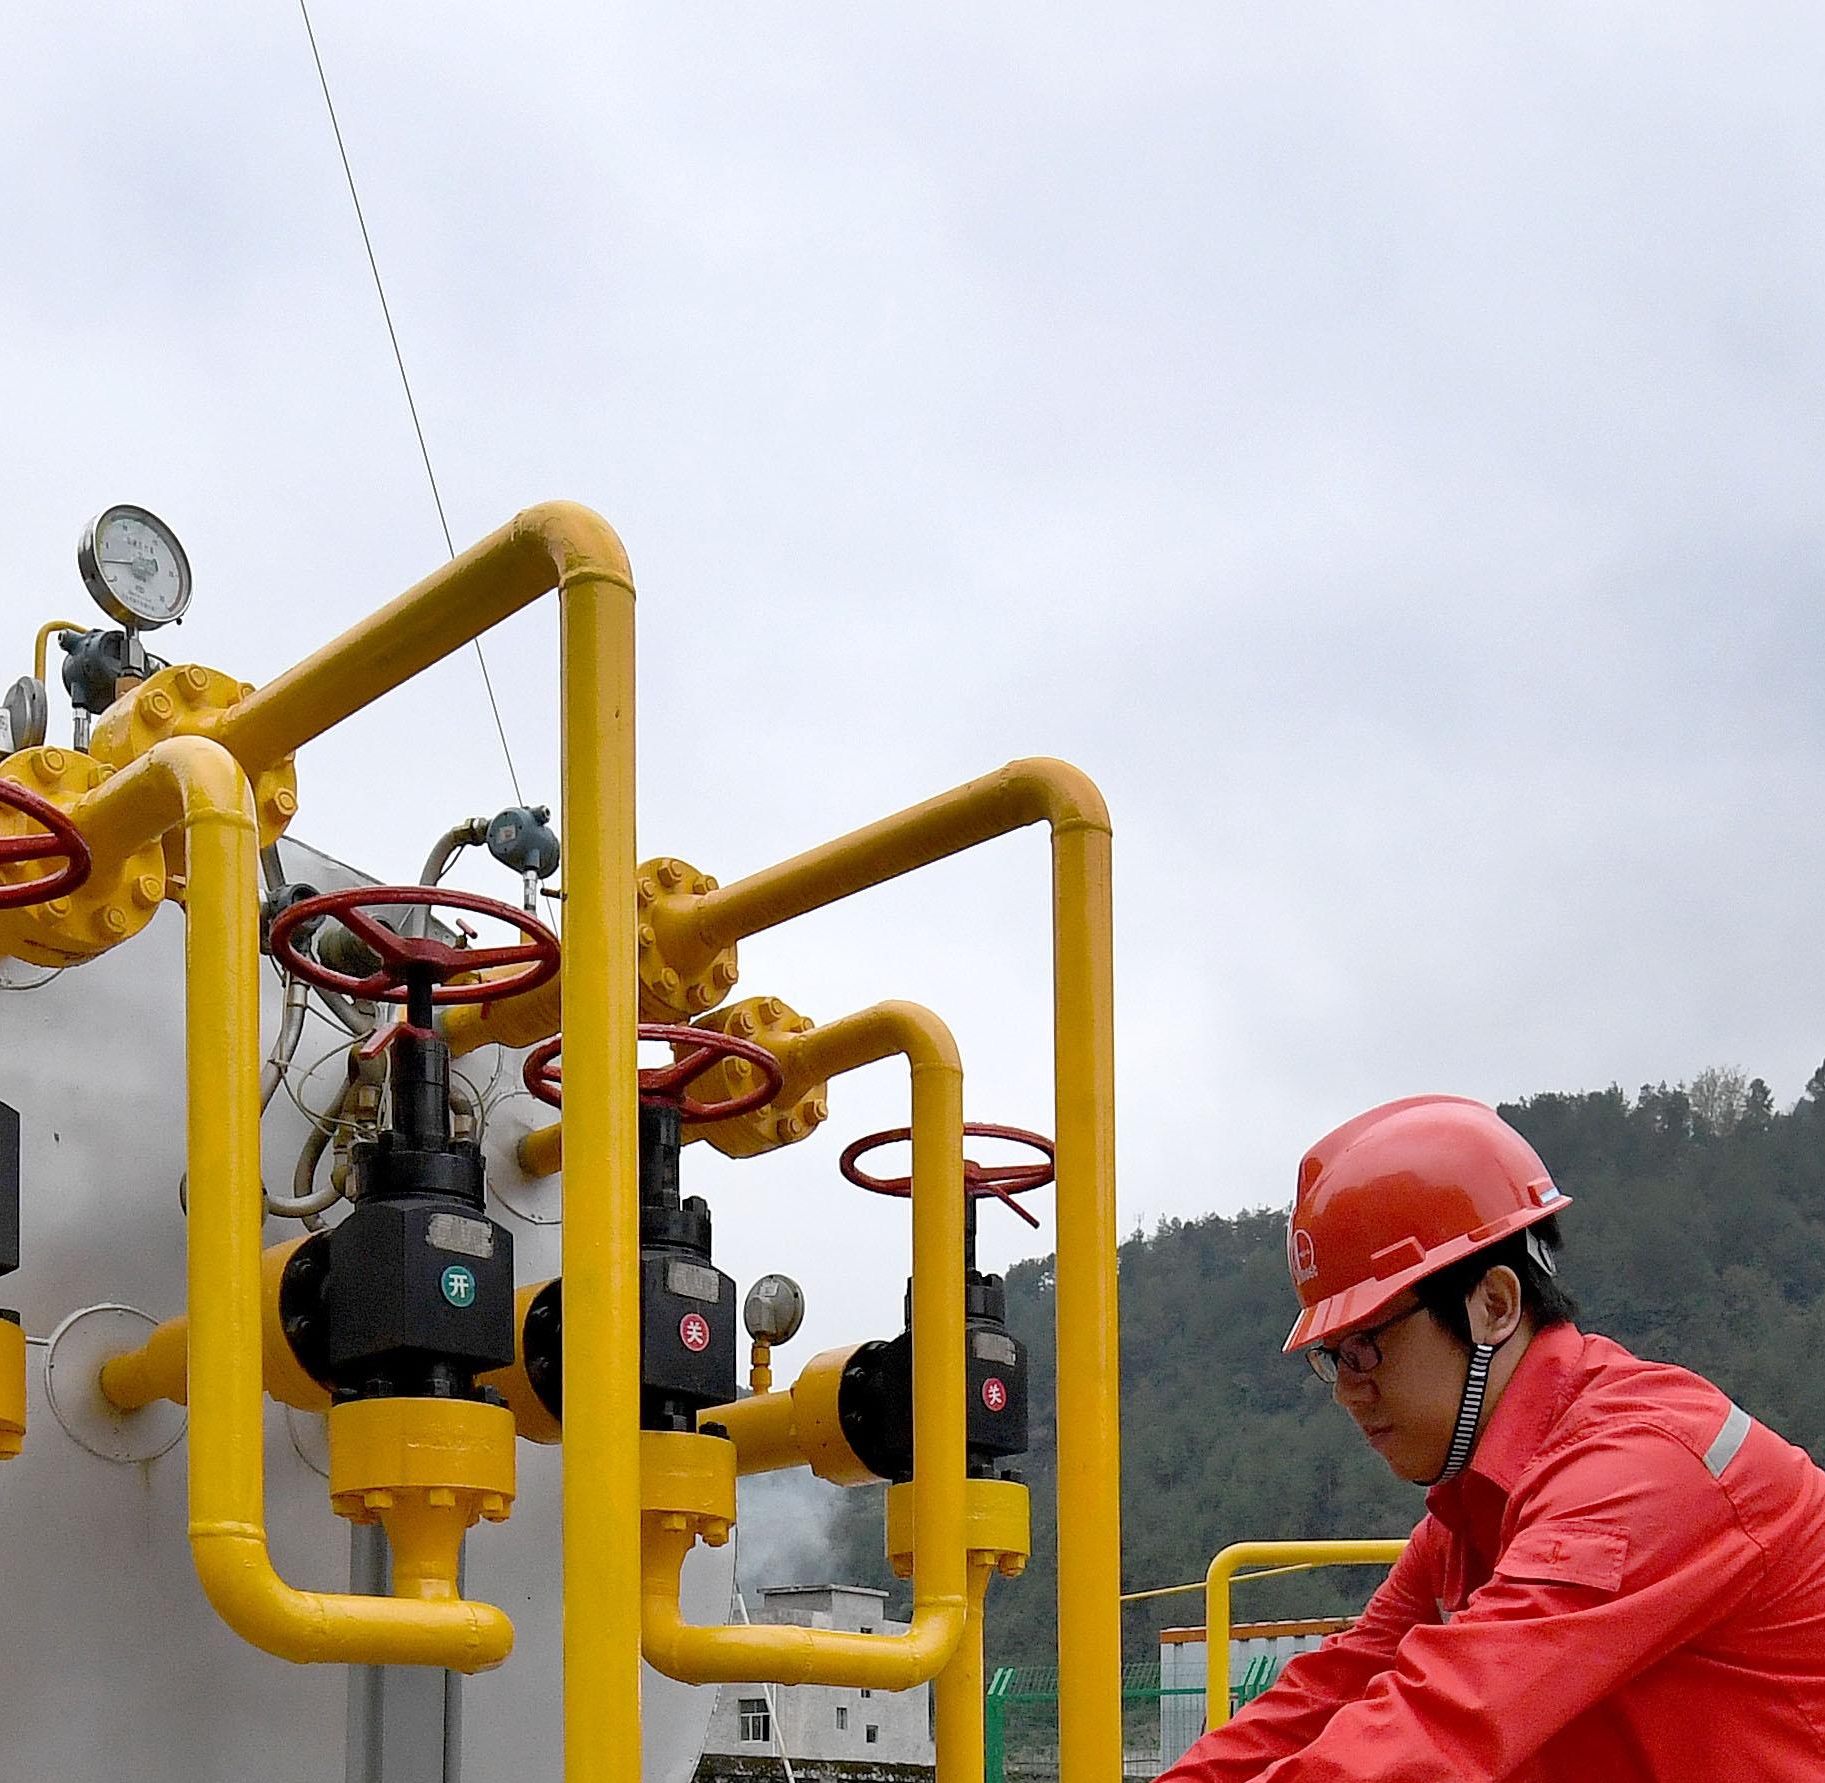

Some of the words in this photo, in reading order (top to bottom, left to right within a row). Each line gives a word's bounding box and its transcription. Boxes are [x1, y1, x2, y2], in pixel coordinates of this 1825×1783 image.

[448, 1273, 469, 1299] 开
[686, 1320, 704, 1345] 关
[987, 1383, 1002, 1406] 关
